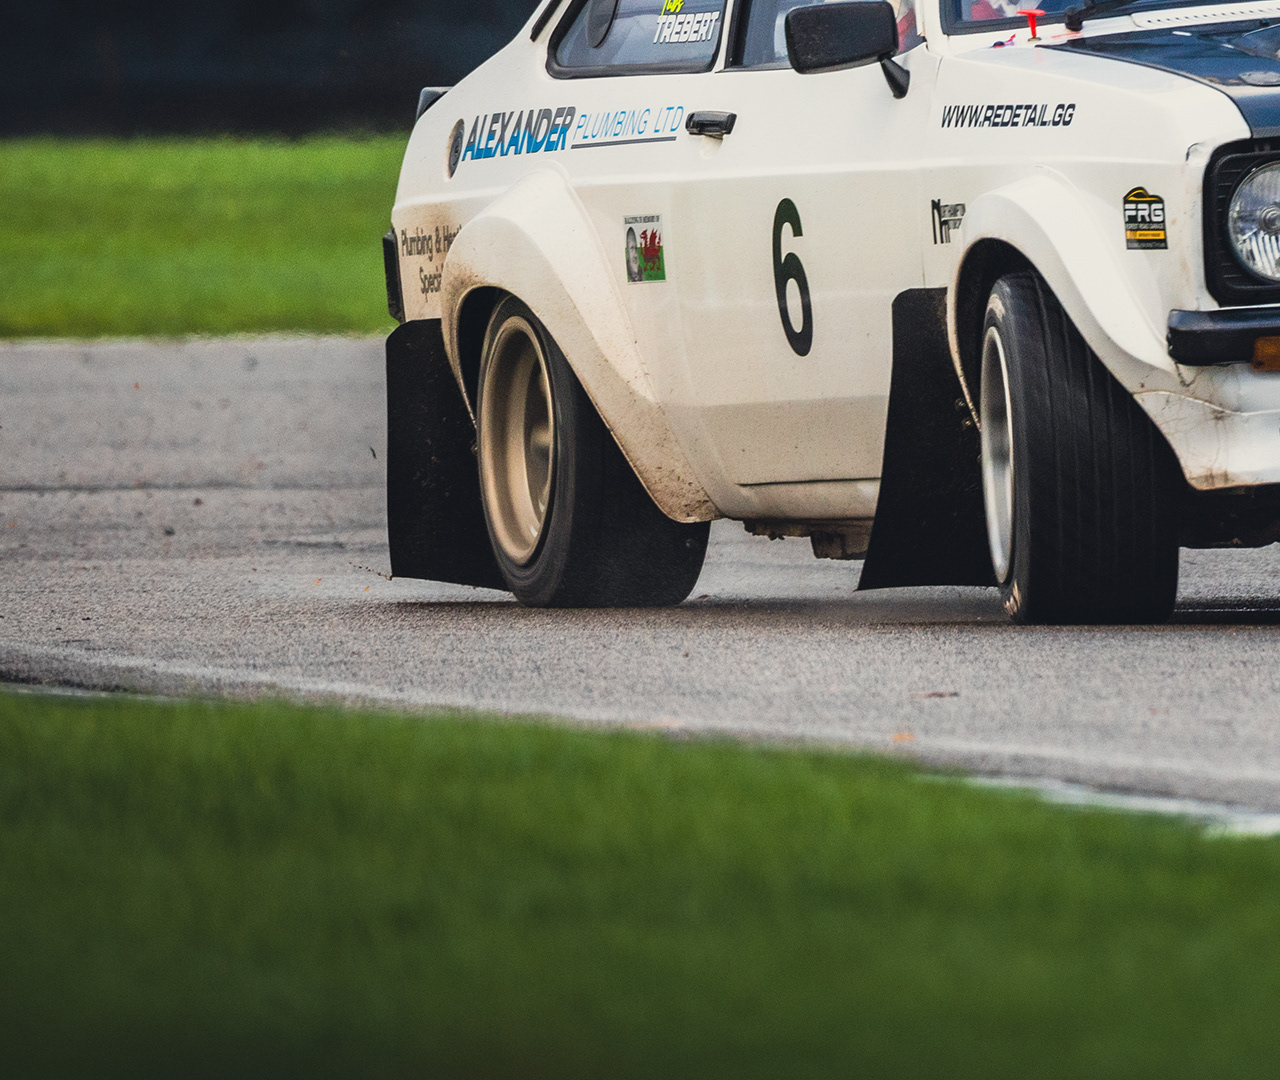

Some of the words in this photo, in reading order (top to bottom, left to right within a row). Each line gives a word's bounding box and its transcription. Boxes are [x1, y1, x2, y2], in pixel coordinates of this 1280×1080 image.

[653, 11, 720, 44] TREBERT
[941, 103, 1076, 128] WWW.REDETAIL.GG
[462, 106, 576, 161] ALEXANDER
[573, 108, 651, 140] PLUMBING
[653, 106, 685, 134] LTD
[1124, 203, 1164, 222] FRG
[401, 227, 433, 262] Plumbing
[771, 197, 813, 357] 6
